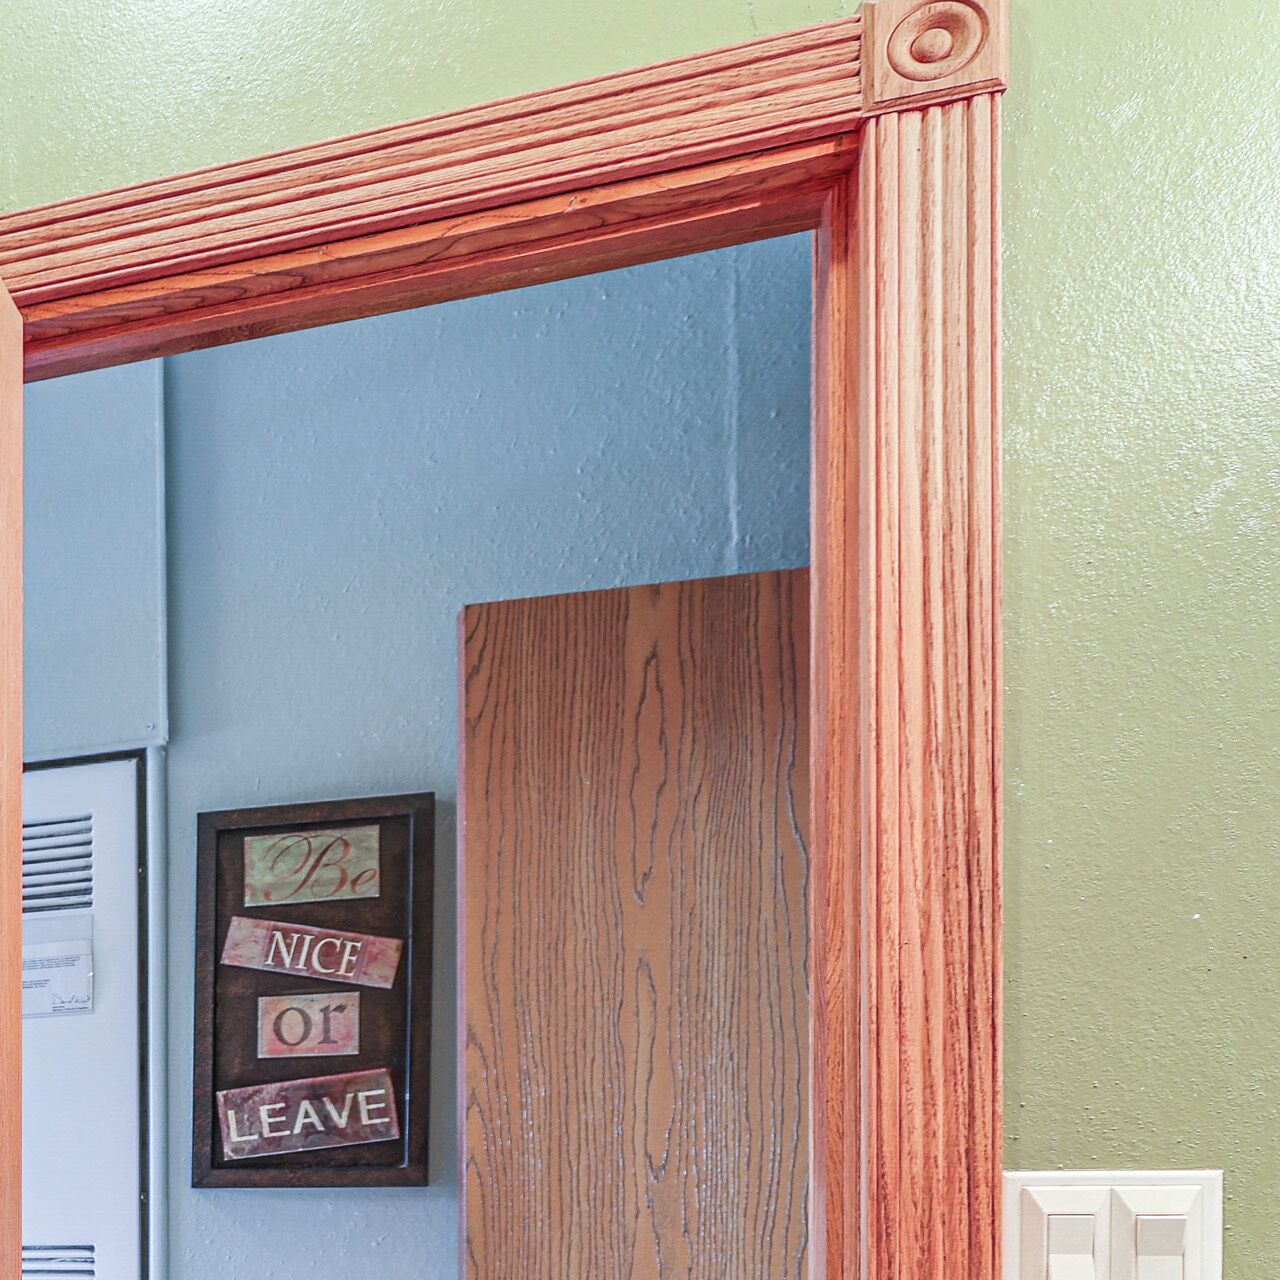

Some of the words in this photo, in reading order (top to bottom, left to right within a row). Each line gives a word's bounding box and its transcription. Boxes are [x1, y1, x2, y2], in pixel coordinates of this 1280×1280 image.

[260, 835, 378, 901] Be
[264, 930, 363, 977] NICE
[273, 1004, 347, 1046] or
[227, 1089, 390, 1142] LEAVE
